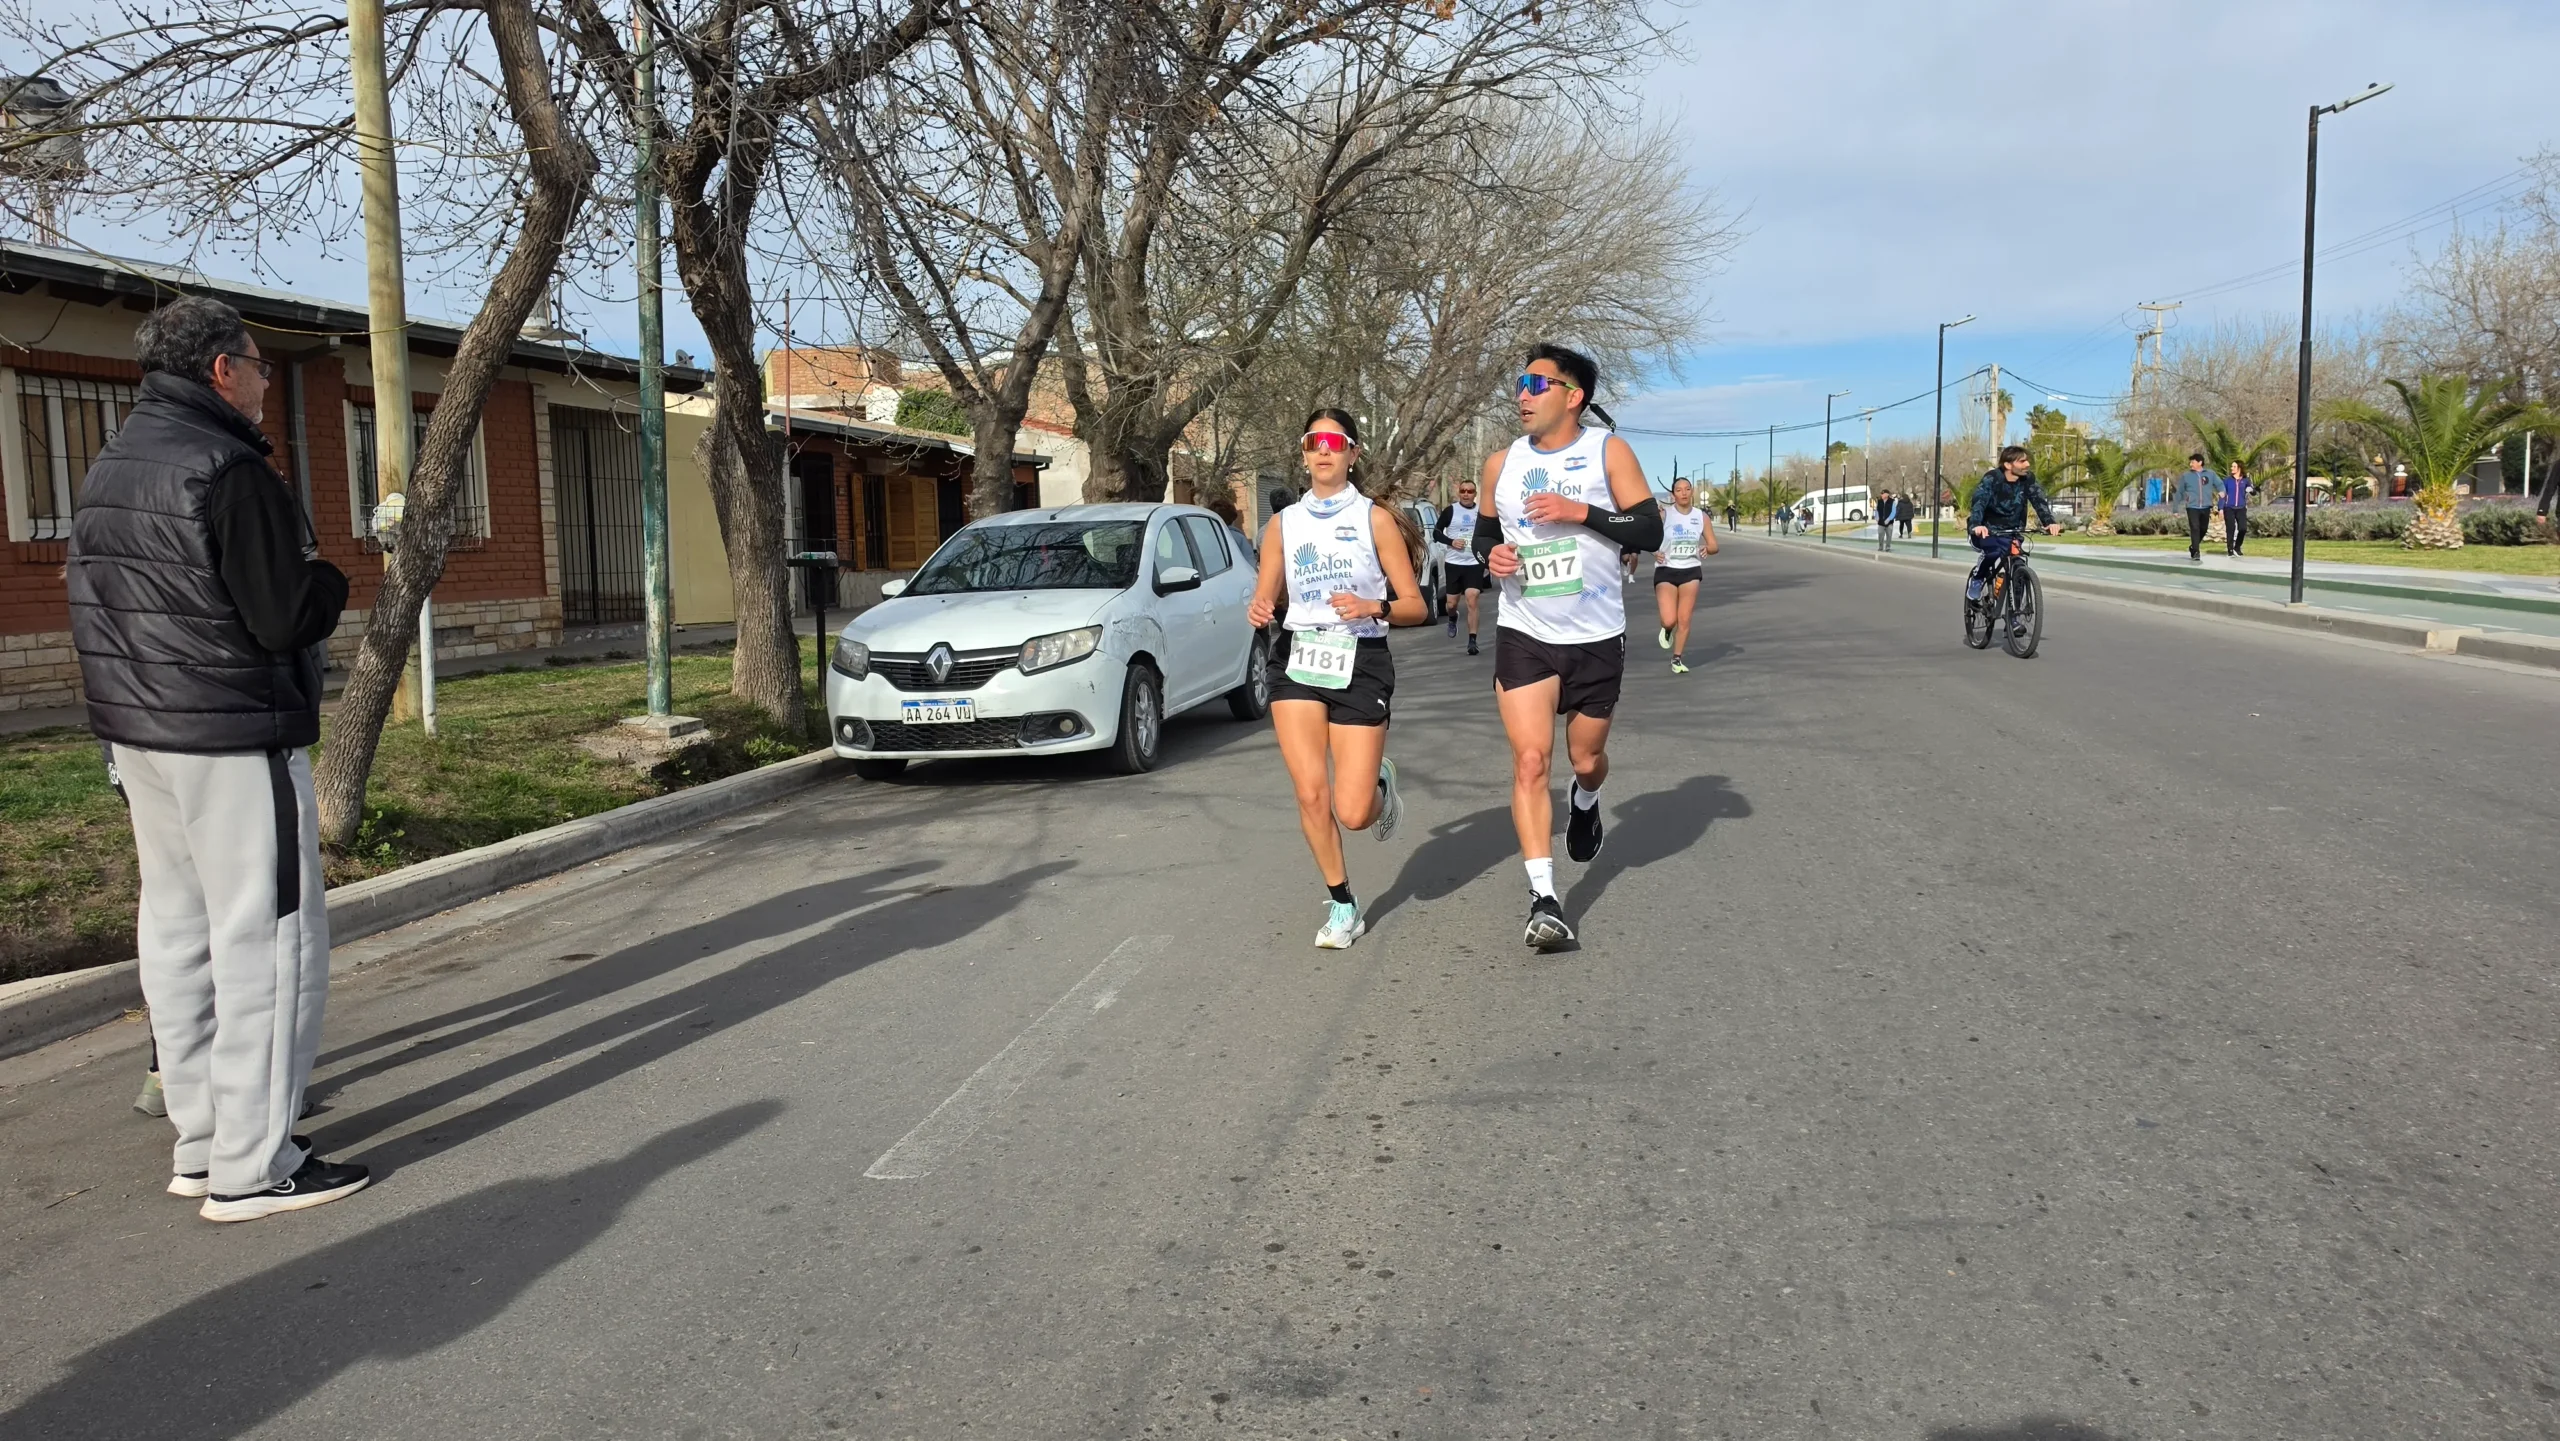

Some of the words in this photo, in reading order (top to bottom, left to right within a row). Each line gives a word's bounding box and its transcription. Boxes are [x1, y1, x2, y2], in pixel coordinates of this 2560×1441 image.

[1532, 545, 1552, 556] 10K
[1673, 546, 1695, 554] 1179
[1294, 554, 1353, 579] MARATON
[1520, 556, 1576, 581] 1017
[1305, 575, 1322, 585] SAN
[1323, 571, 1353, 581] RAFAEL
[1295, 646, 1347, 671] 1181
[906, 708, 922, 722] AA
[926, 707, 951, 721] 264
